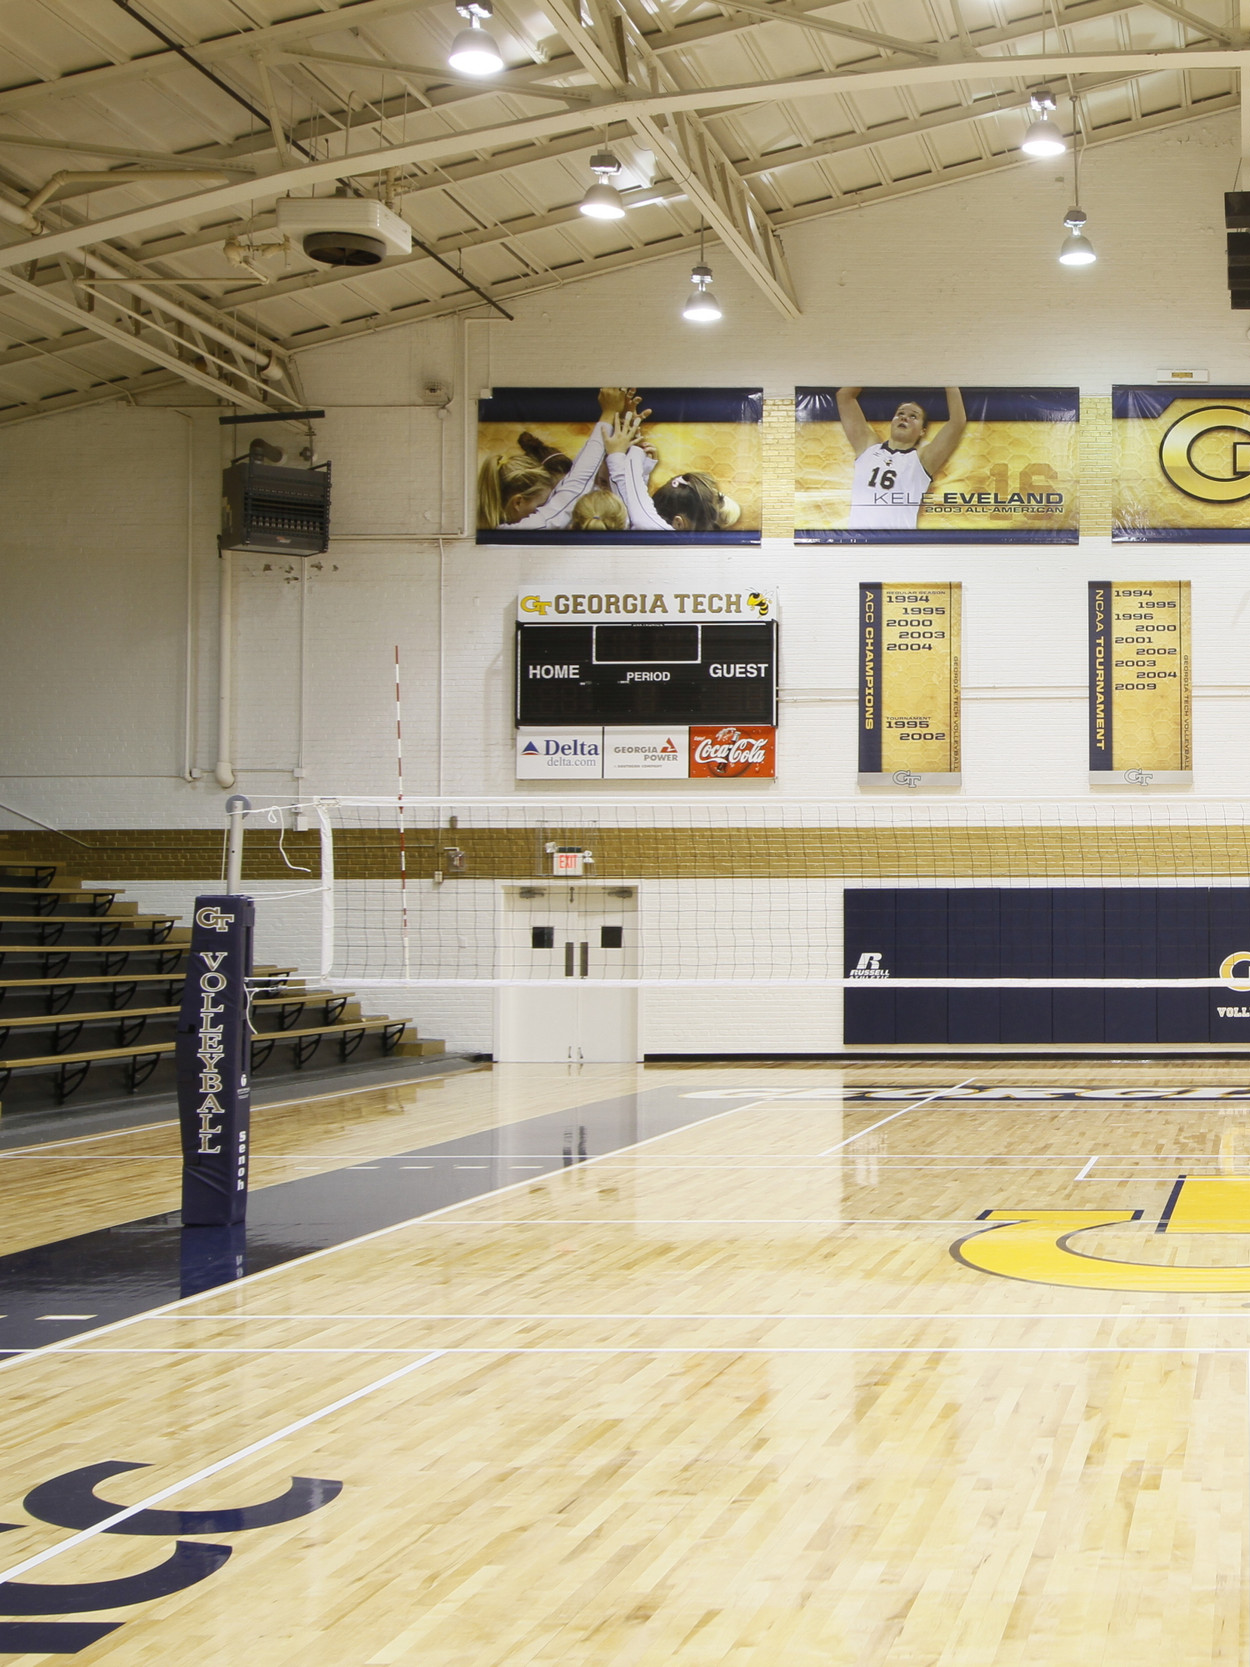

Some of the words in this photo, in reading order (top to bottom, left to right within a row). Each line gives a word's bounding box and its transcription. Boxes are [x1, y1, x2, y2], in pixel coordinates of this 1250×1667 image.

[868, 467, 897, 490] 16
[874, 492, 934, 505] KELE
[943, 492, 1064, 505] EVELAND
[520, 595, 552, 616] GT
[554, 594, 669, 614] GEORGIA
[674, 593, 742, 613] TECH
[887, 595, 930, 603] 1994
[1138, 601, 1177, 609] 1995
[865, 591, 874, 623] ACC
[902, 607, 946, 615] 1995
[1095, 589, 1104, 632] NCAA
[886, 619, 933, 627] 2000
[899, 631, 946, 639] 2003
[1114, 636, 1153, 644] 2001
[886, 643, 933, 651] 2004
[528, 664, 580, 679] HOME
[626, 671, 671, 682] PERIOD
[709, 663, 769, 678] GUEST
[1136, 671, 1177, 679] 2004
[865, 627, 874, 730] CHAMPIONS
[1095, 636, 1105, 750] TOURNAMENT
[886, 721, 930, 729] 1995
[544, 739, 600, 756] Delta
[614, 746, 658, 754] GEORGIA
[695, 738, 768, 764] Coca-Cola
[547, 756, 596, 767] delta.com
[643, 754, 679, 762] POWER
[559, 854, 578, 869] EXIT
[196, 951, 229, 1154] VOLLEYBALL
[236, 1130, 247, 1191] senoh
